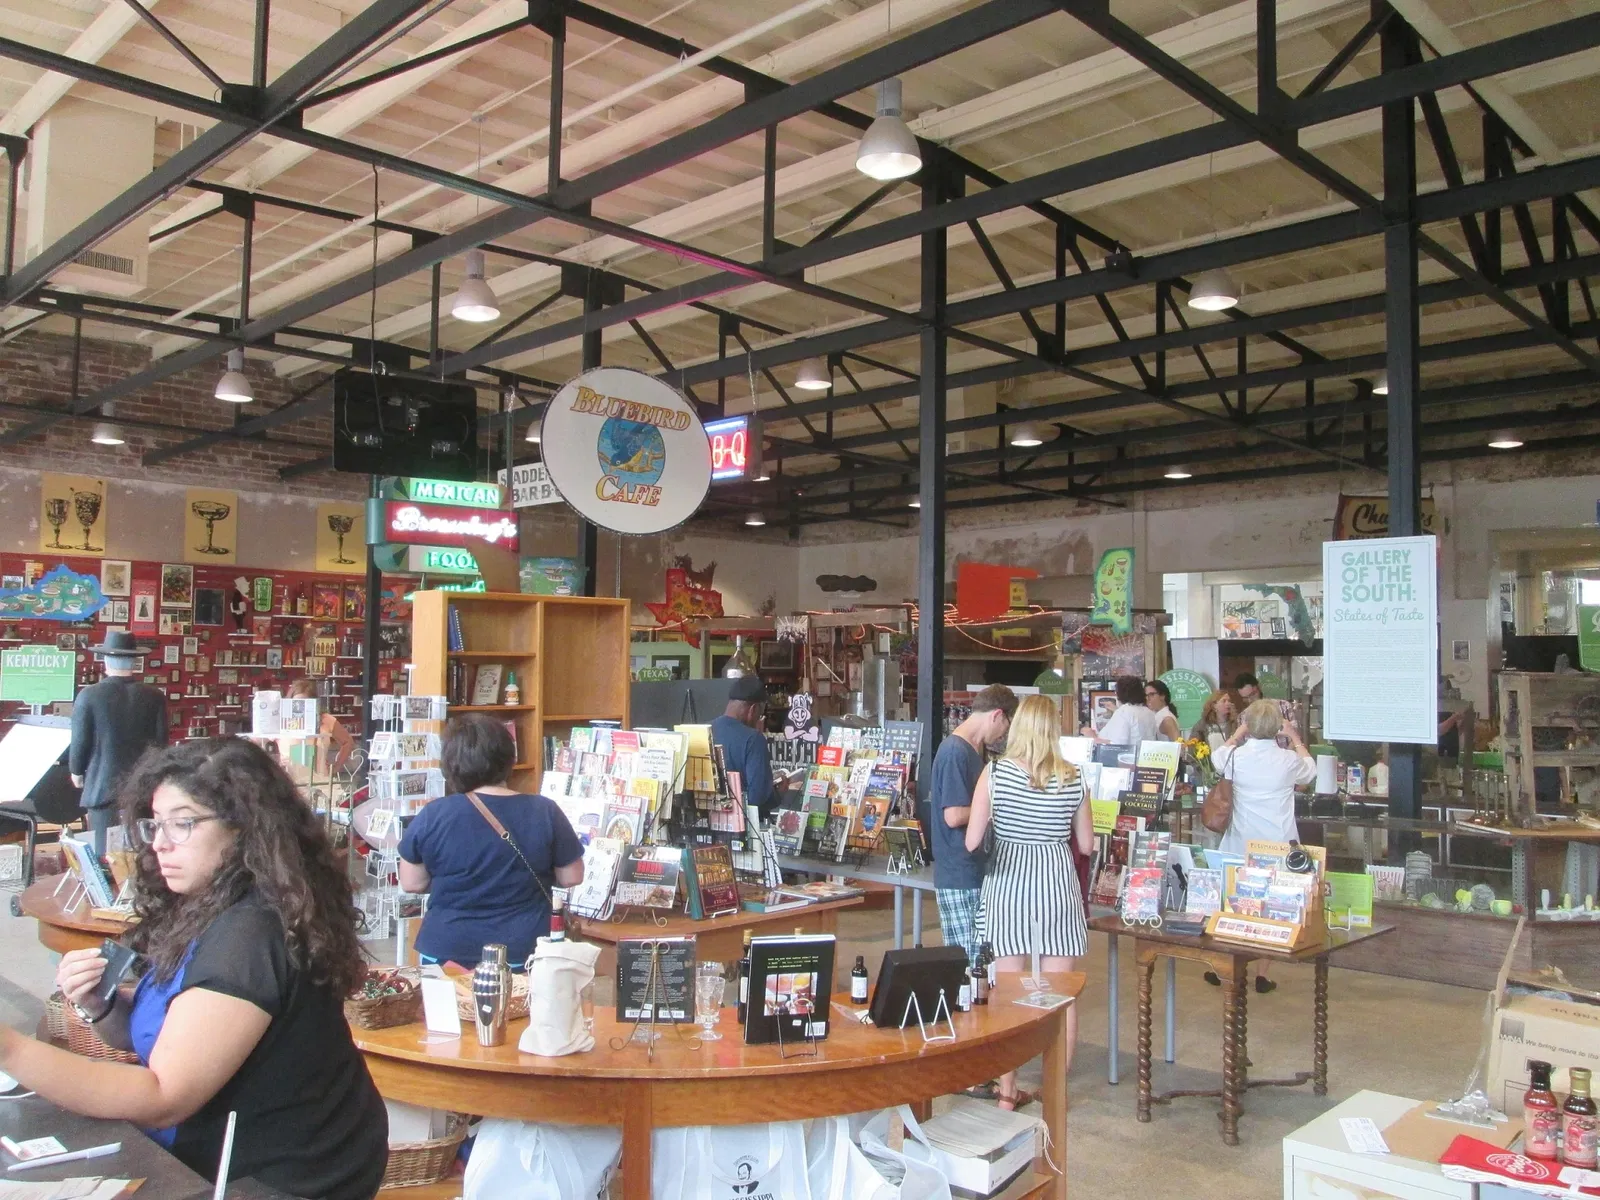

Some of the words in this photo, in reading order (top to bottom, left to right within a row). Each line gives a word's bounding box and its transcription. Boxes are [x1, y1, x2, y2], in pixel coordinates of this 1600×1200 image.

[569, 386, 692, 432] BLUEBIRD
[414, 482, 500, 504] MEXICAN
[594, 474, 663, 507] CAFE
[1341, 549, 1411, 566] GALLERY
[1341, 566, 1371, 584] OF
[1377, 565, 1412, 583] THE
[1341, 583, 1417, 603] SOUTH:
[1333, 608, 1372, 623] States
[1375, 609, 1388, 628] of
[1391, 608, 1425, 623] Taste
[6, 654, 69, 668] KENTUCKY
[642, 669, 669, 678] TEXAS
[1124, 801, 1157, 809] COCKTAILS
[1537, 1043, 1557, 1052] bring
